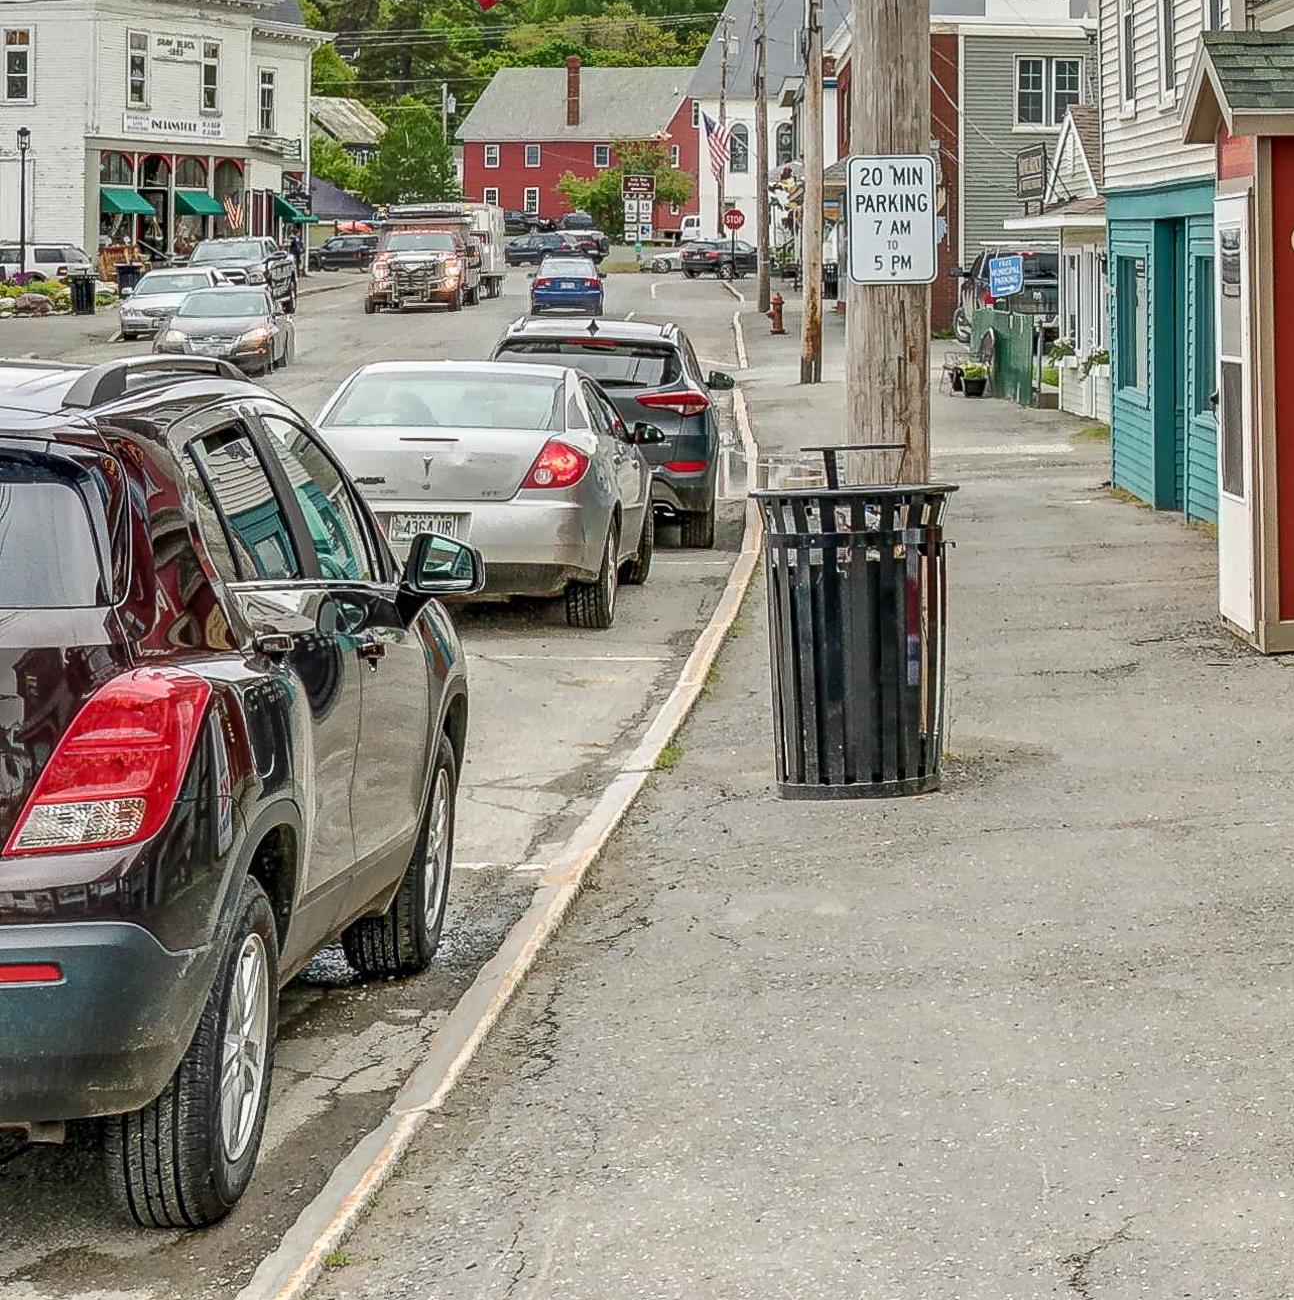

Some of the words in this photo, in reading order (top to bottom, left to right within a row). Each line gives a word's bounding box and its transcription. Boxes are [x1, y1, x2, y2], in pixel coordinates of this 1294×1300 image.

[860, 167, 882, 187] 20
[893, 167, 923, 186] MIN
[855, 193, 928, 213] PARKING
[726, 215, 744, 225] STOP
[874, 220, 883, 235] 7
[890, 220, 911, 235] AM
[887, 240, 898, 250] TO
[874, 255, 883, 271] 5
[891, 255, 912, 270] PM
